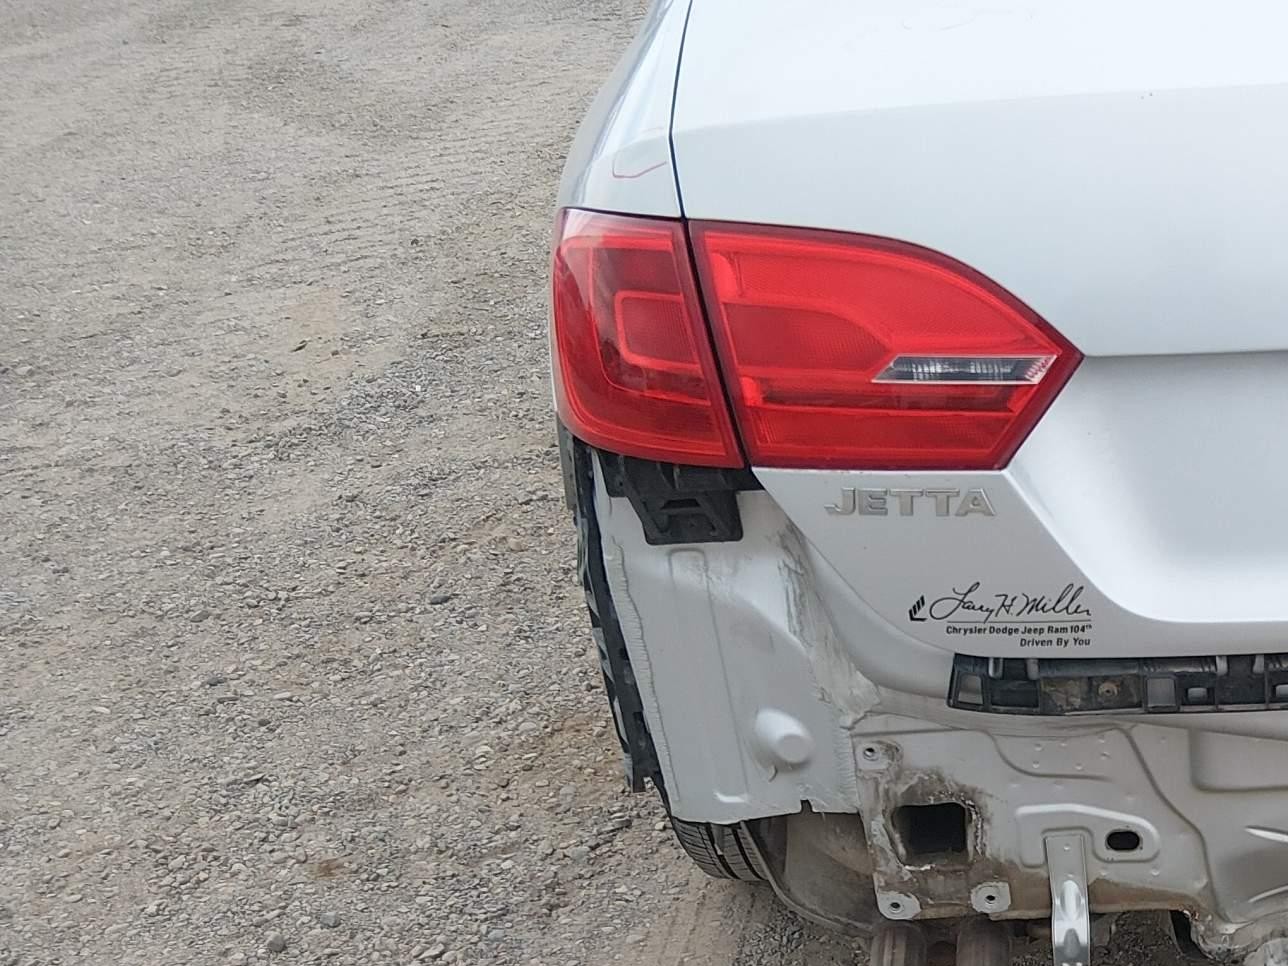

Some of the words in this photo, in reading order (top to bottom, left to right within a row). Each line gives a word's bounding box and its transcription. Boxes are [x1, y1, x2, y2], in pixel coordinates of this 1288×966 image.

[824, 487, 996, 517] JETTA
[1017, 583, 1092, 617] Miller
[946, 625, 987, 636] Chrysler
[989, 625, 1020, 635] Dodge
[1021, 625, 1045, 635] Jeep
[1047, 624, 1069, 634] Ram
[1070, 624, 1093, 633] 104th
[1019, 638, 1052, 647] Driven
[1056, 637, 1070, 648] By
[1072, 637, 1092, 646] You
